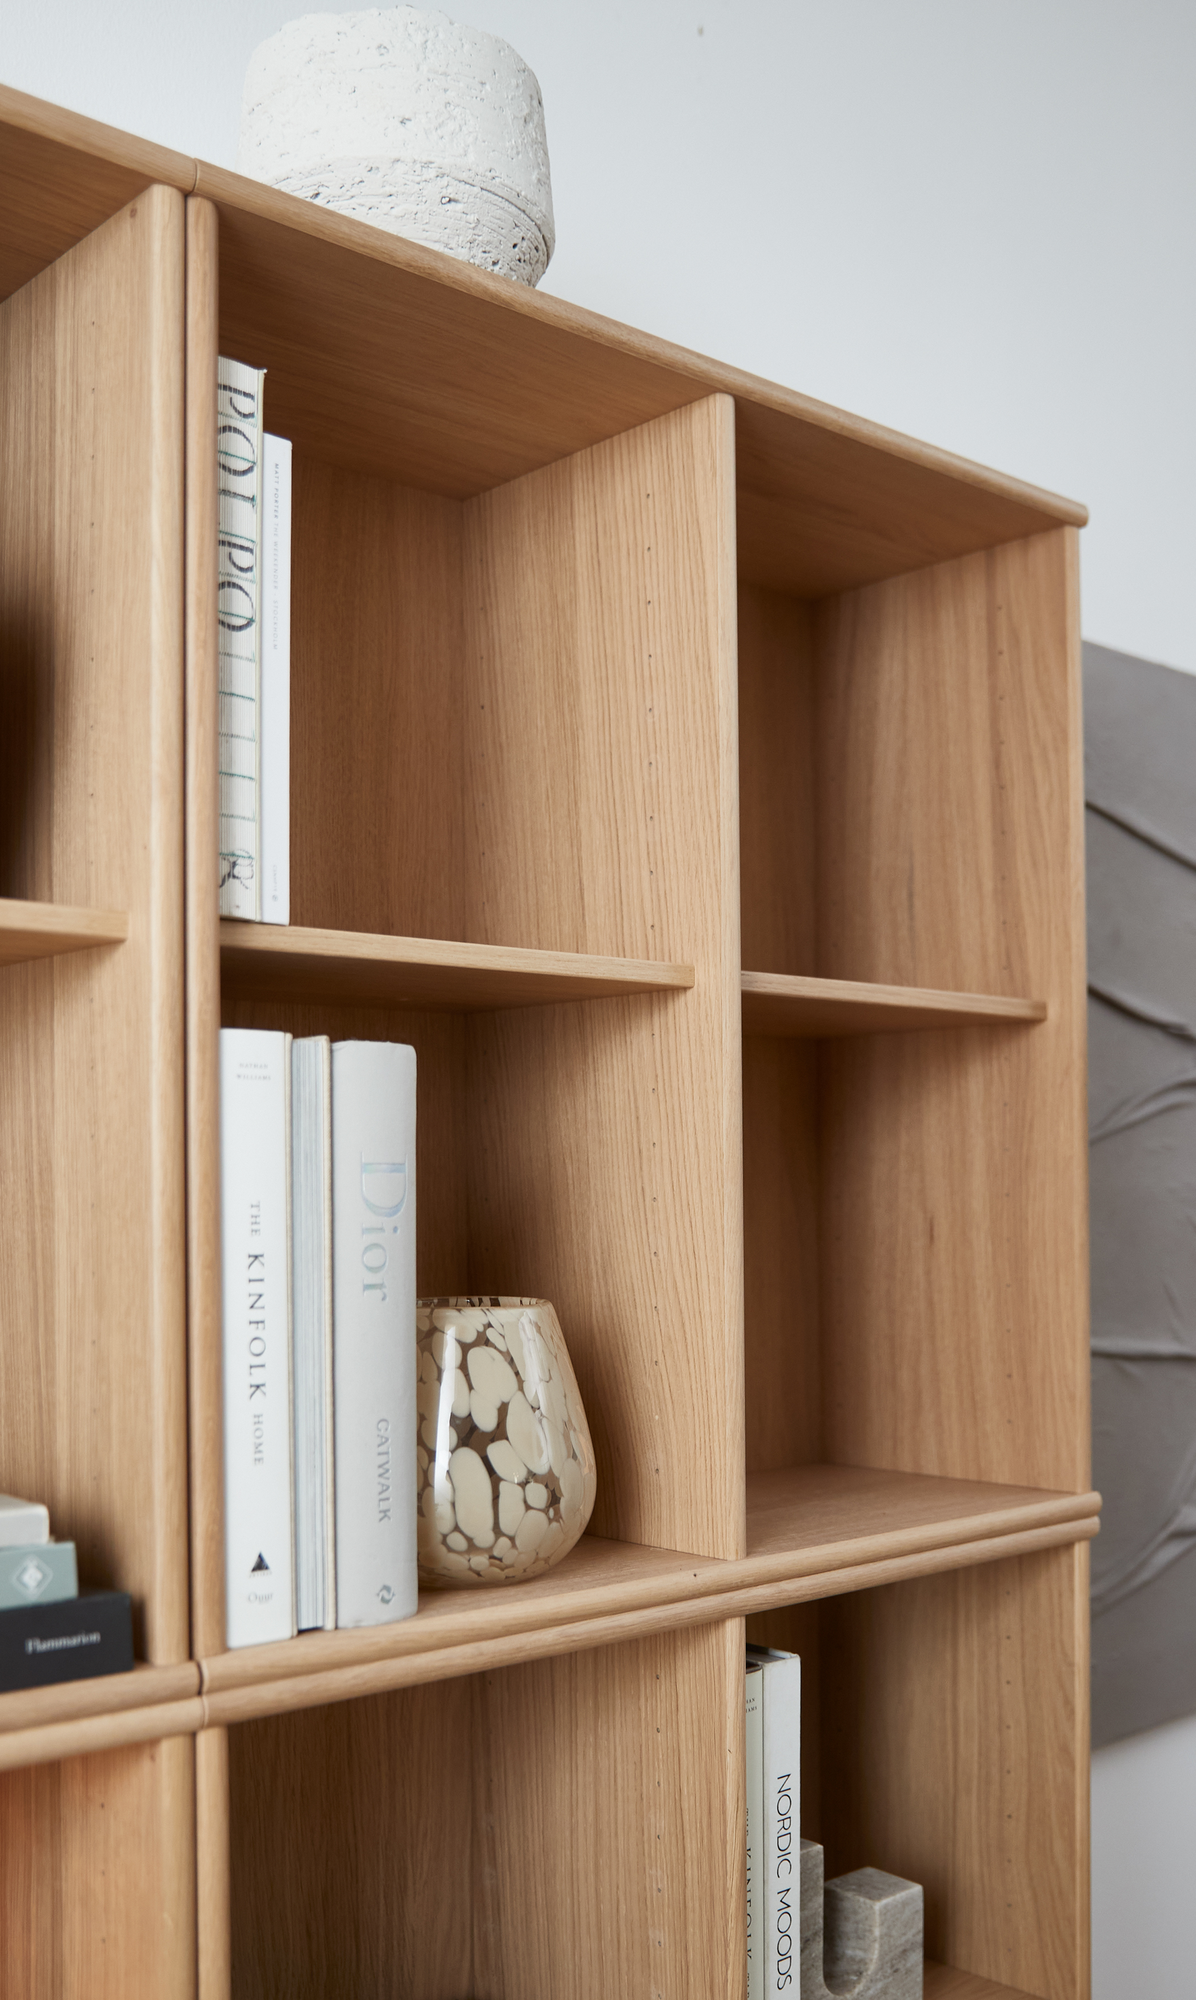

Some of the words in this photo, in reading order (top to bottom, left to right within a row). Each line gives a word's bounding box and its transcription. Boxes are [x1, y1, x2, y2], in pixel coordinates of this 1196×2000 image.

[250, 1201, 261, 1237] THE
[361, 1152, 407, 1301] Dior
[248, 1253, 266, 1400] KINFOLK
[253, 1413, 264, 1466] HOME
[376, 1418, 392, 1523] CATWALK
[25, 1630, 101, 1654] Flammarion
[777, 1773, 792, 1878] NORDIC
[777, 1888, 792, 1990] MOODS
